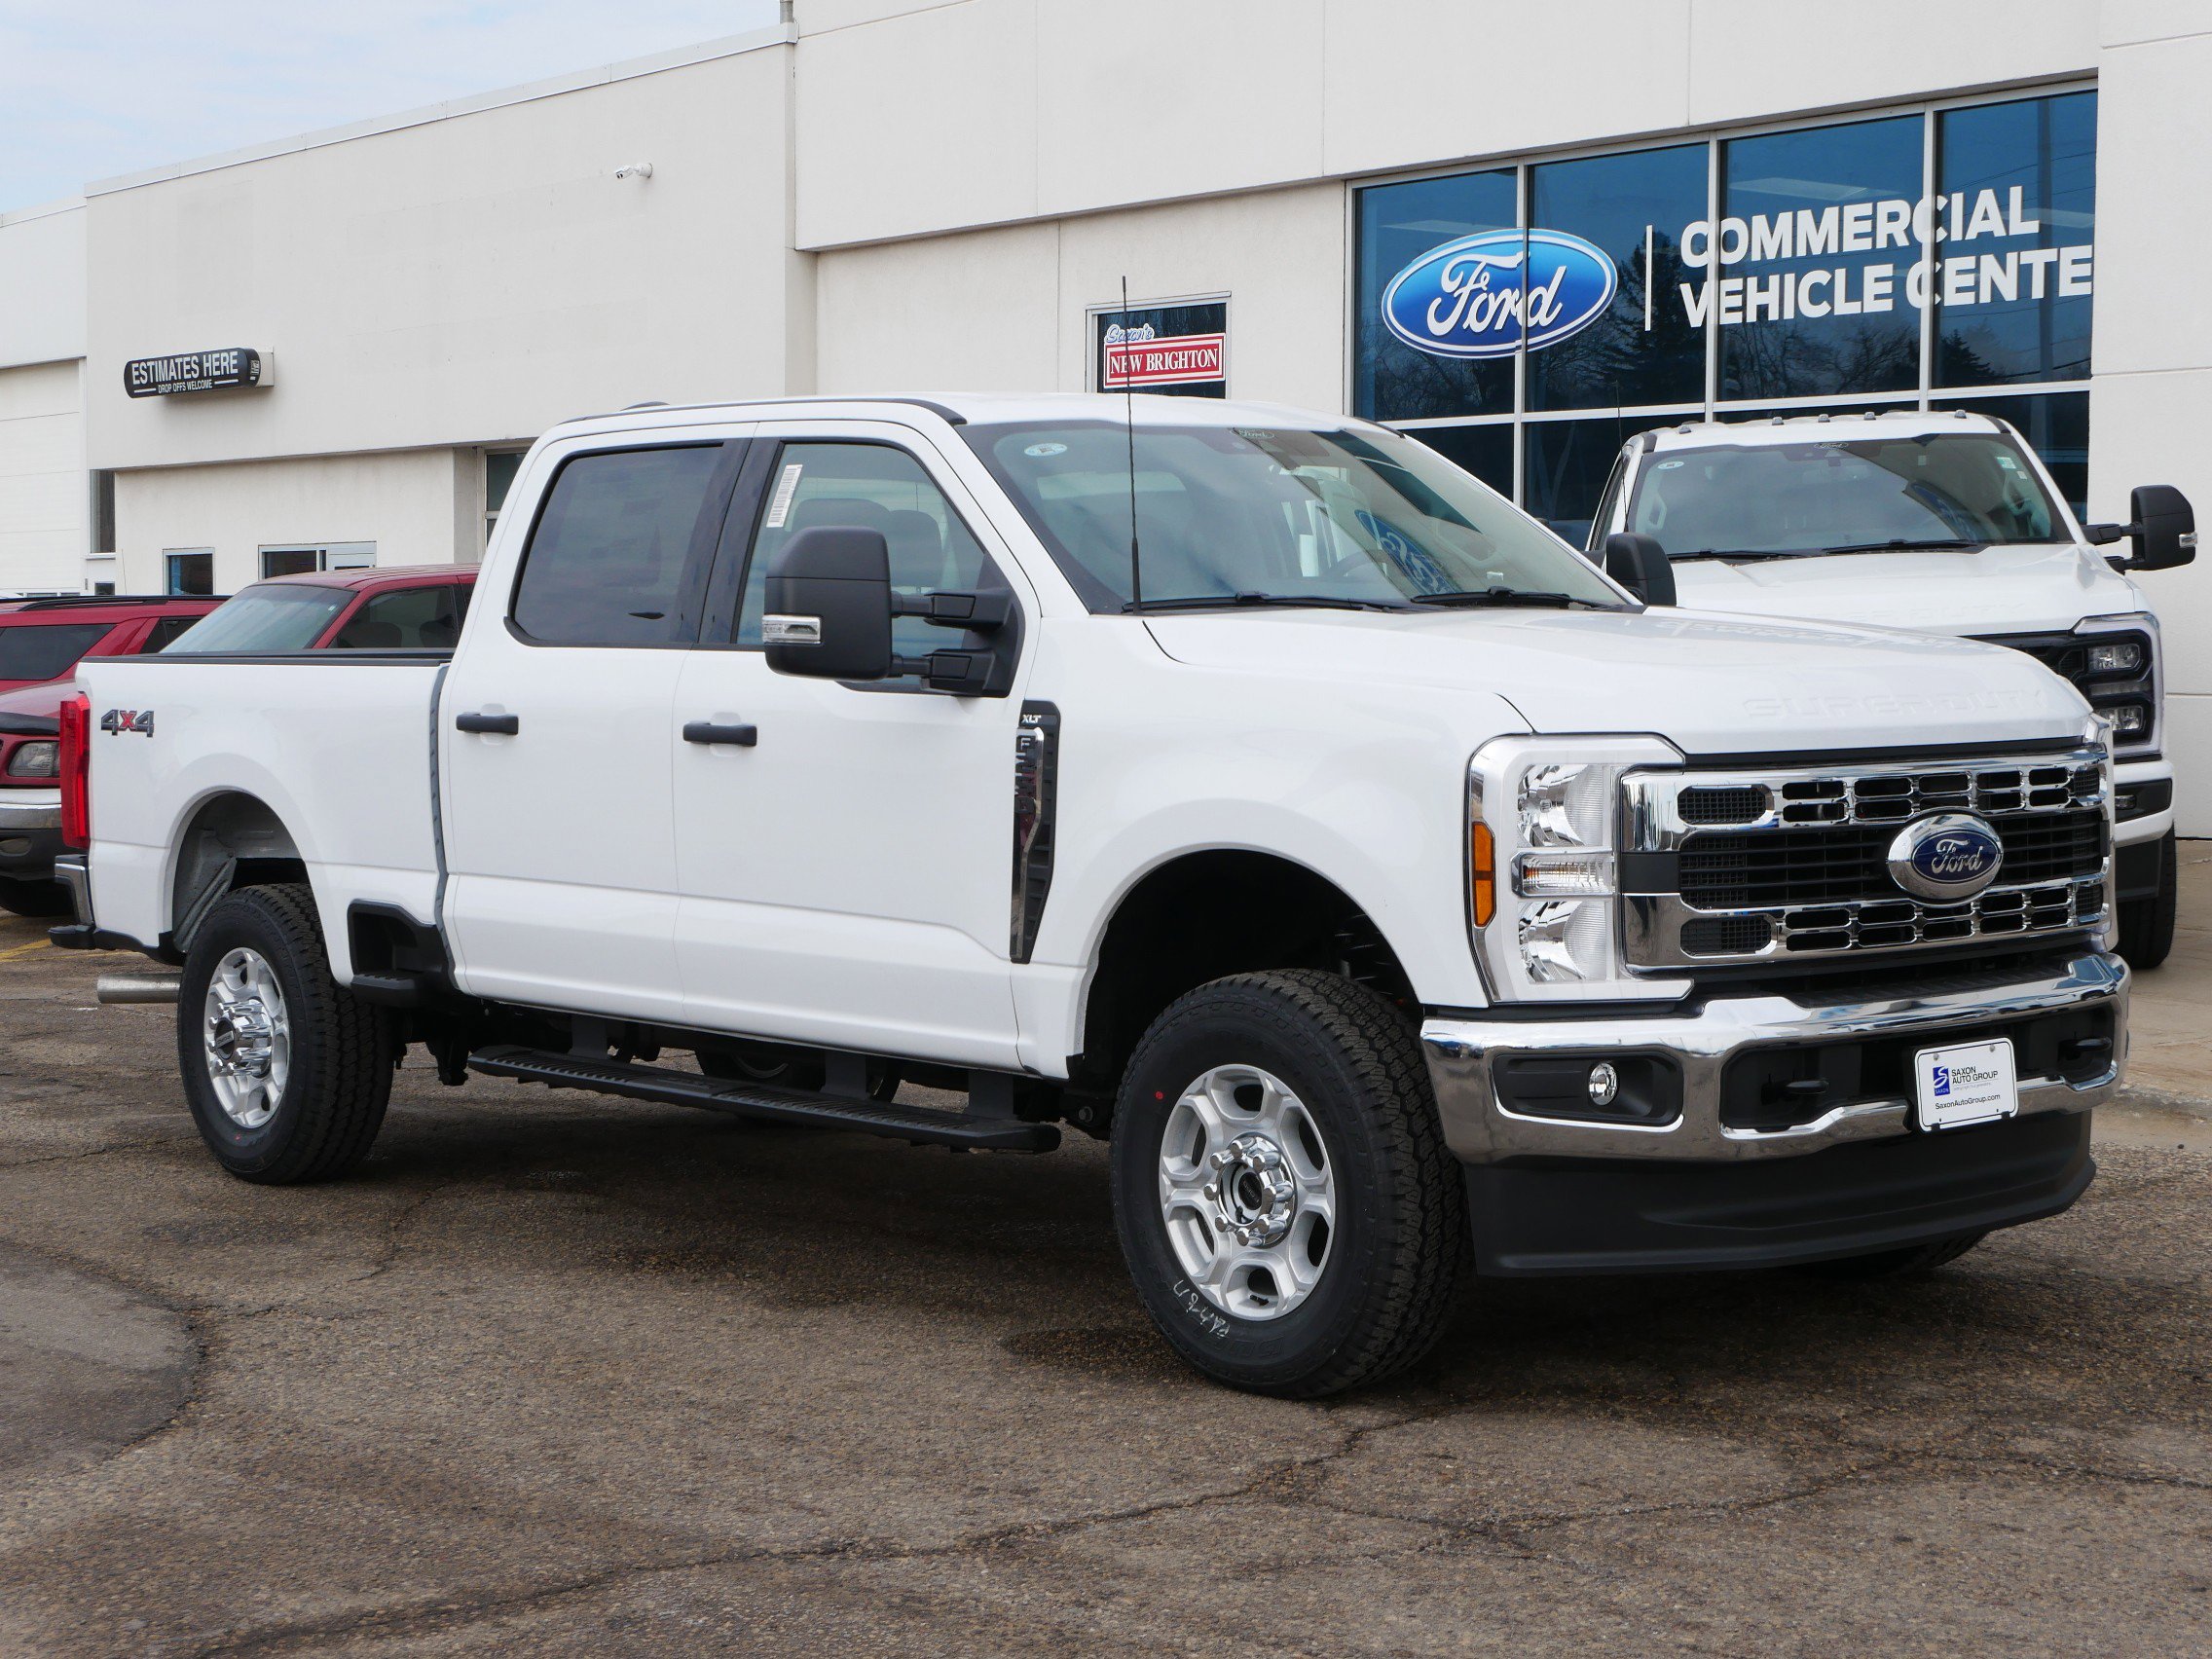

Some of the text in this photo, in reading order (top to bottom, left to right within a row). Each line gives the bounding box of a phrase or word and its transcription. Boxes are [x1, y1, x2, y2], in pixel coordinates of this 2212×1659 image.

[1680, 186, 2041, 268] COMMERCIAL
[1427, 250, 1567, 336] Ford
[1680, 244, 2093, 328] VEHICLE CENTE
[131, 355, 200, 385] ESTIMATES
[203, 351, 239, 377] HERE
[1110, 349, 1218, 374] NEW BRIGHTON
[158, 379, 213, 394] DROP OFFS WELCOME
[1021, 714, 1042, 724] XLT
[1932, 838, 1984, 874] Ford
[1951, 1066, 1976, 1077] SAXON
[1952, 1071, 1999, 1085] AUTO GROUP
[1936, 1094, 2001, 1110] SaxonAutoGroup.com
